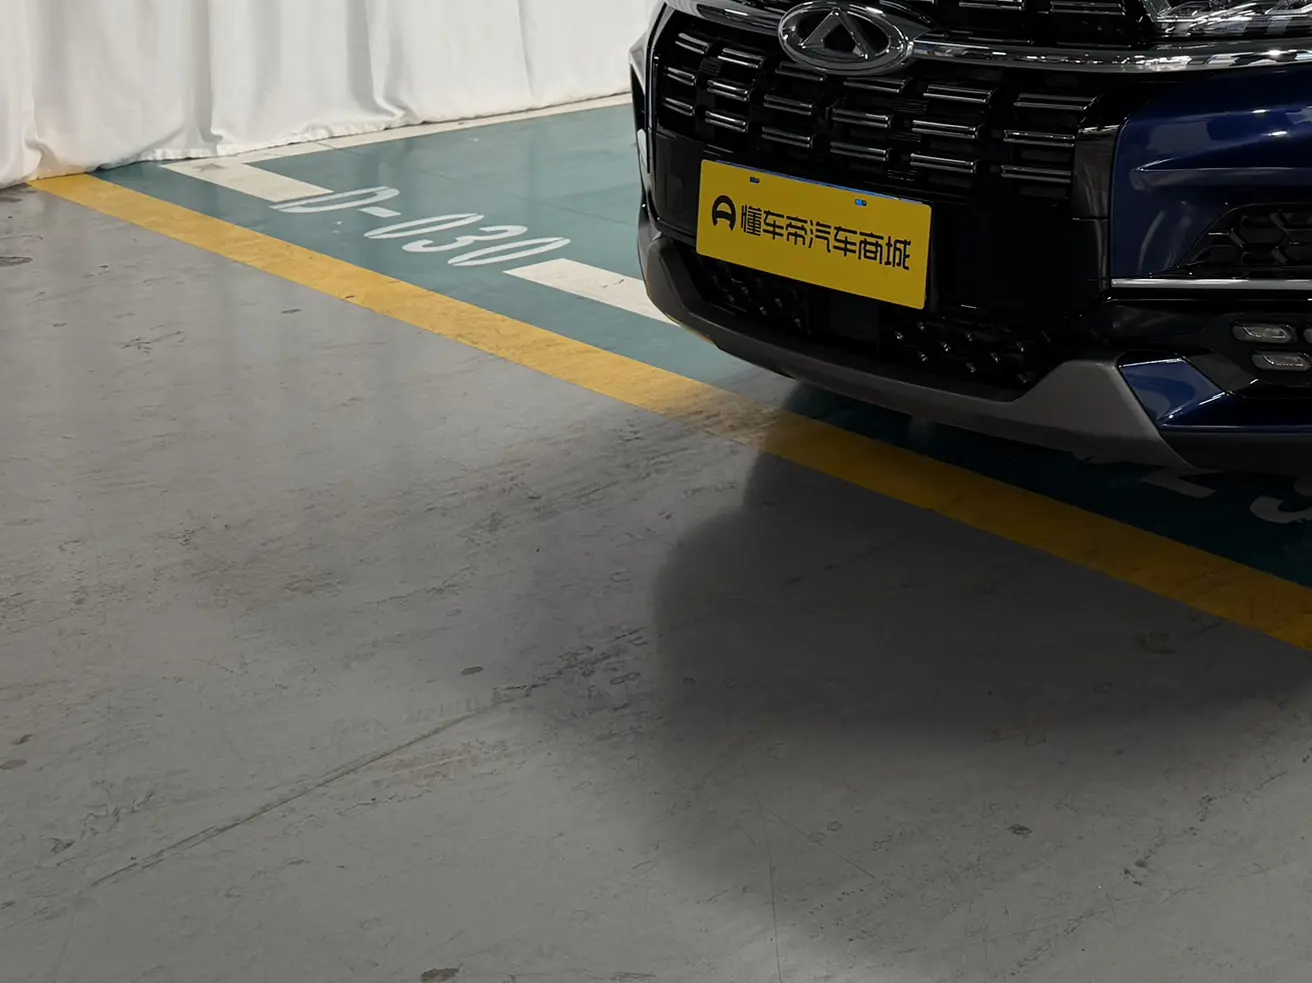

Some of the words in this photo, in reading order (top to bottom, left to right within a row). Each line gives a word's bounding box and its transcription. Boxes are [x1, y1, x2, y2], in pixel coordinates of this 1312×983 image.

[268, 185, 572, 266] D-030
[741, 203, 912, 271] 懂车帝汽车商城
